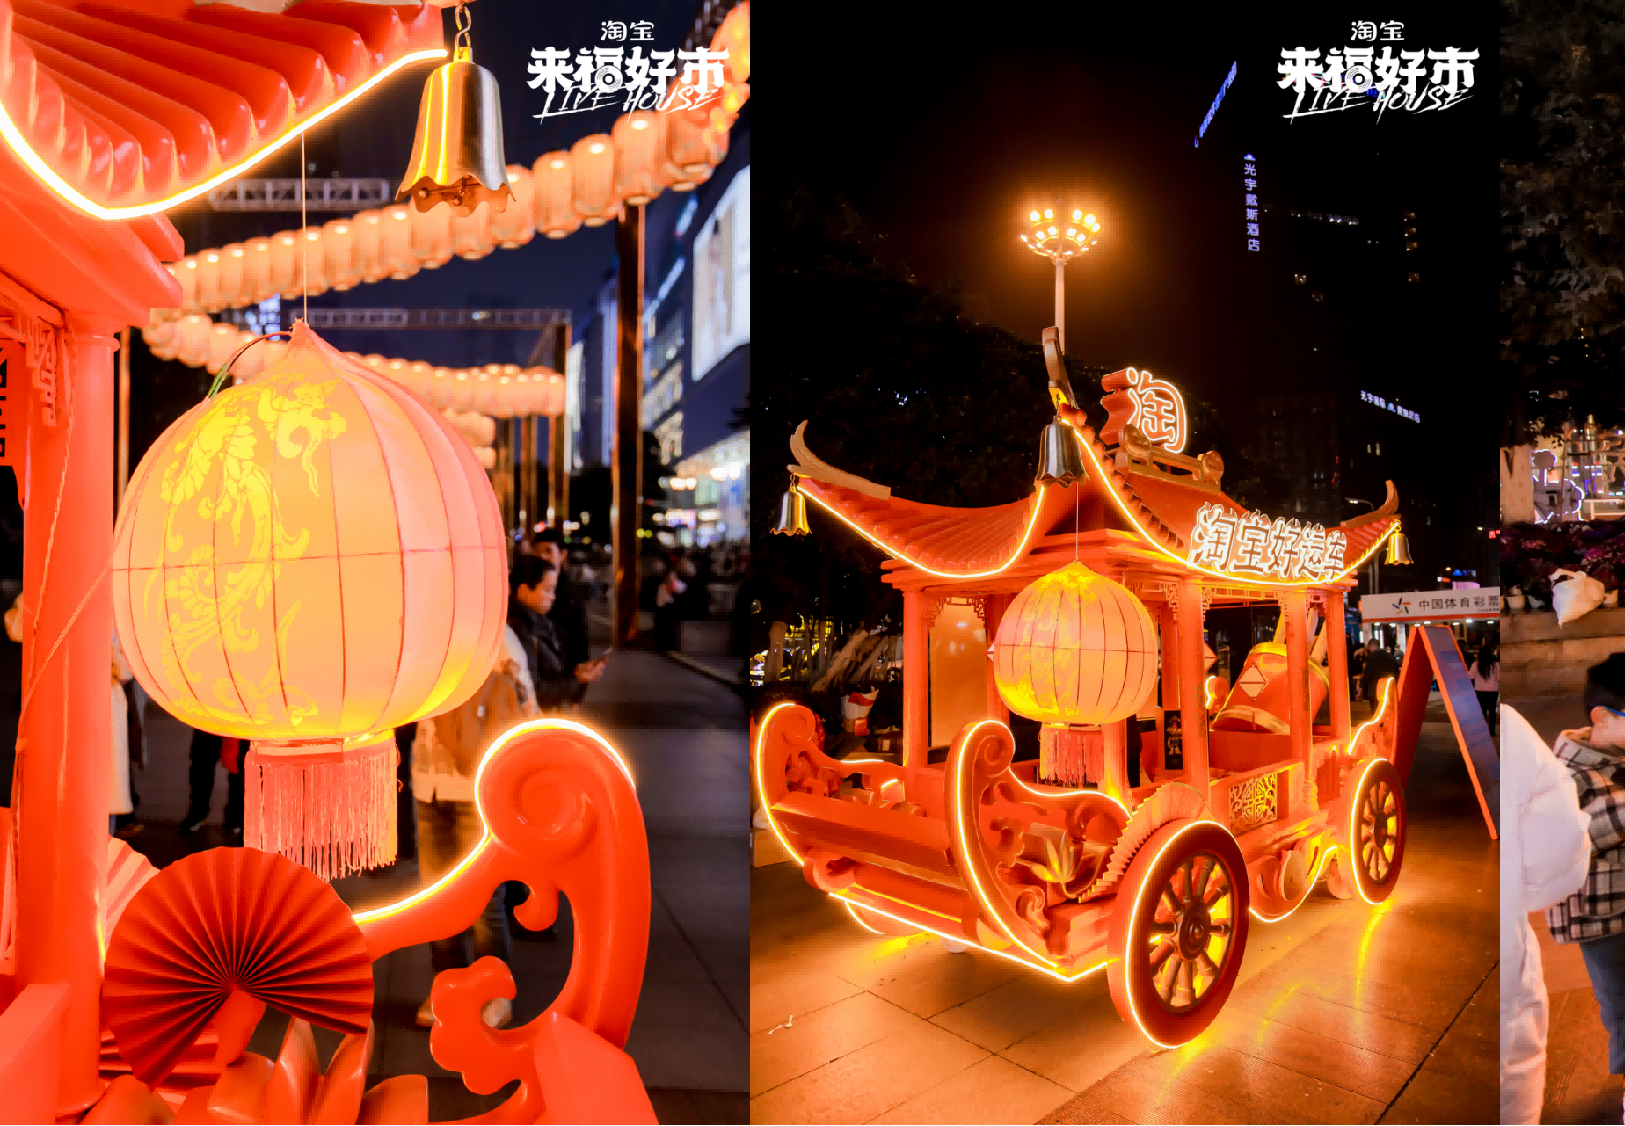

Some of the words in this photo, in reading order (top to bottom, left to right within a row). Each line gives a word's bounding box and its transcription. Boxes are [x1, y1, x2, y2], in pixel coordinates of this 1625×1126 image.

[1243, 162, 1260, 252] 光宇戴斯酒店
[1126, 366, 1188, 454] 淘
[1187, 502, 1348, 585] 淘宝好运车
[1418, 594, 1501, 611] 中国体育彩票
